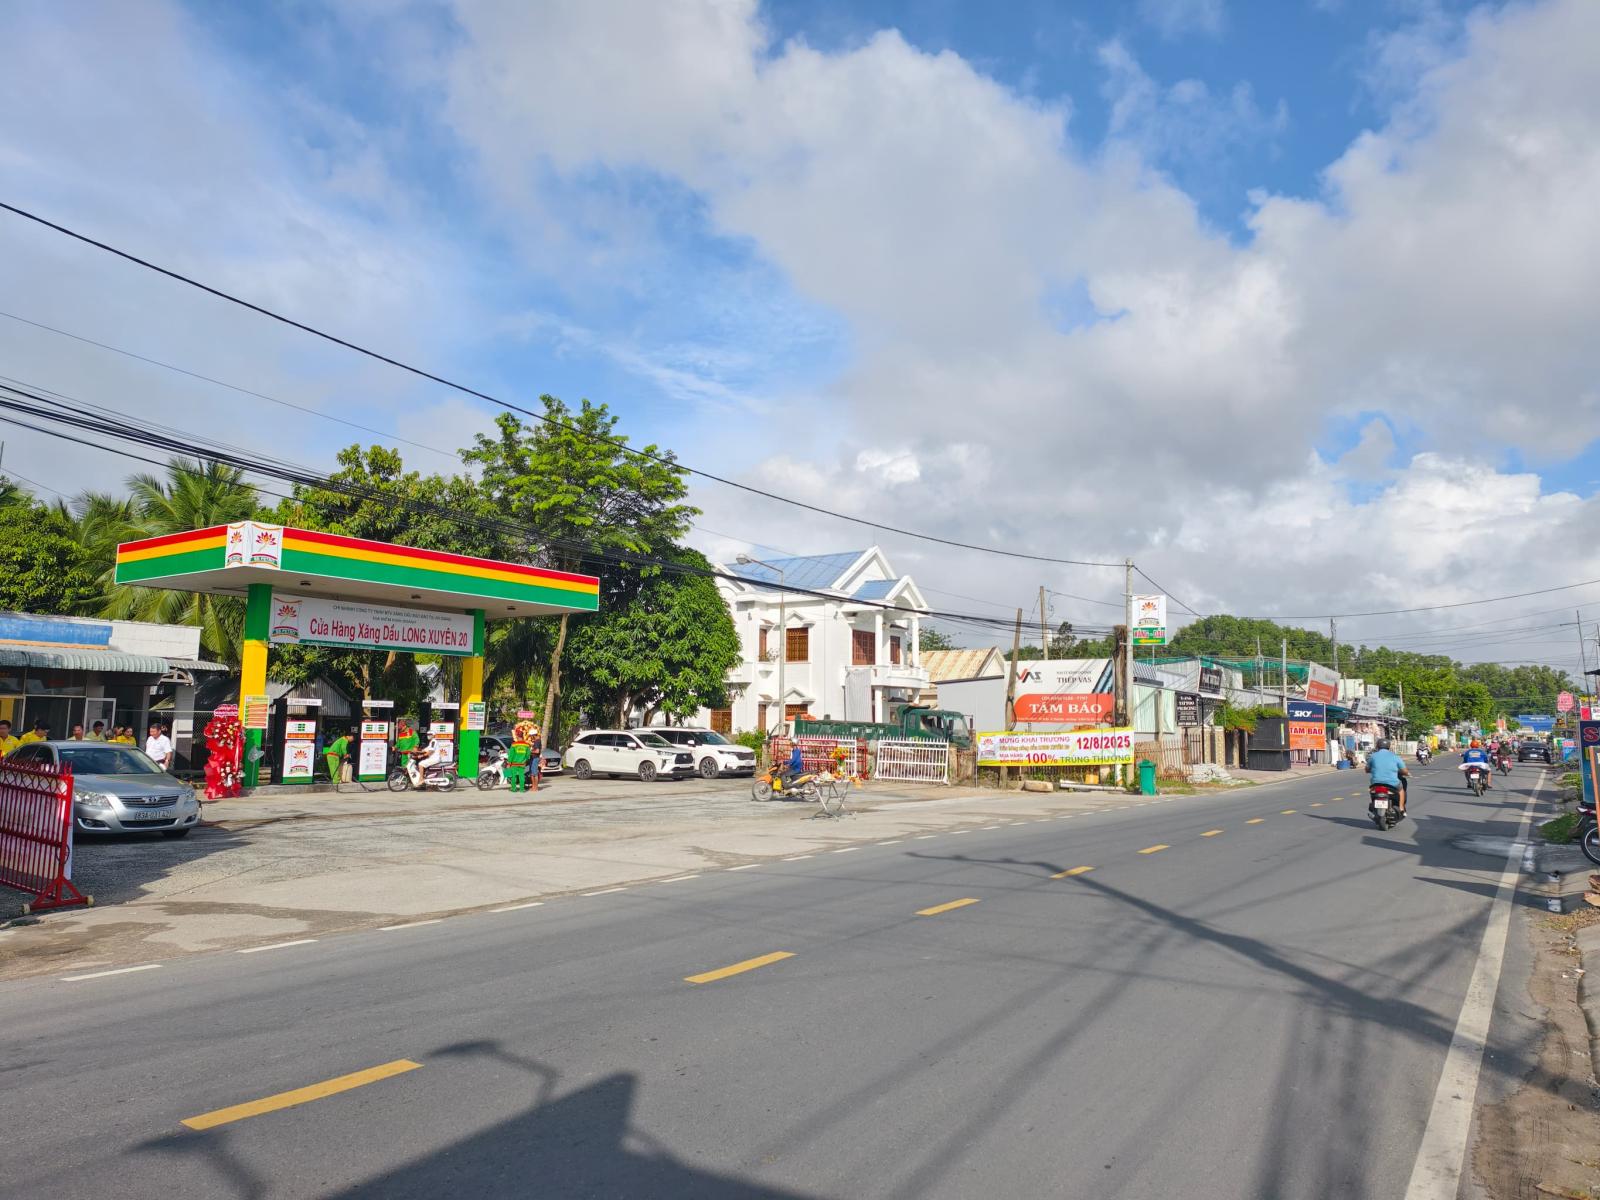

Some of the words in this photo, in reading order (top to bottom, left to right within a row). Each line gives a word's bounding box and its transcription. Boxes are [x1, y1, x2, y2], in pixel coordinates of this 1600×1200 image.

[310, 617, 328, 635] Cửa
[331, 619, 356, 641] Hàng
[357, 622, 380, 644] Xăng
[402, 626, 426, 643] LONG
[428, 627, 456, 646] XUYÊN
[459, 632, 468, 647] 20
[1077, 735, 1131, 750] 12/8/2025
[1026, 752, 1058, 764] 100%
[1061, 754, 1089, 763] TRÚNG
